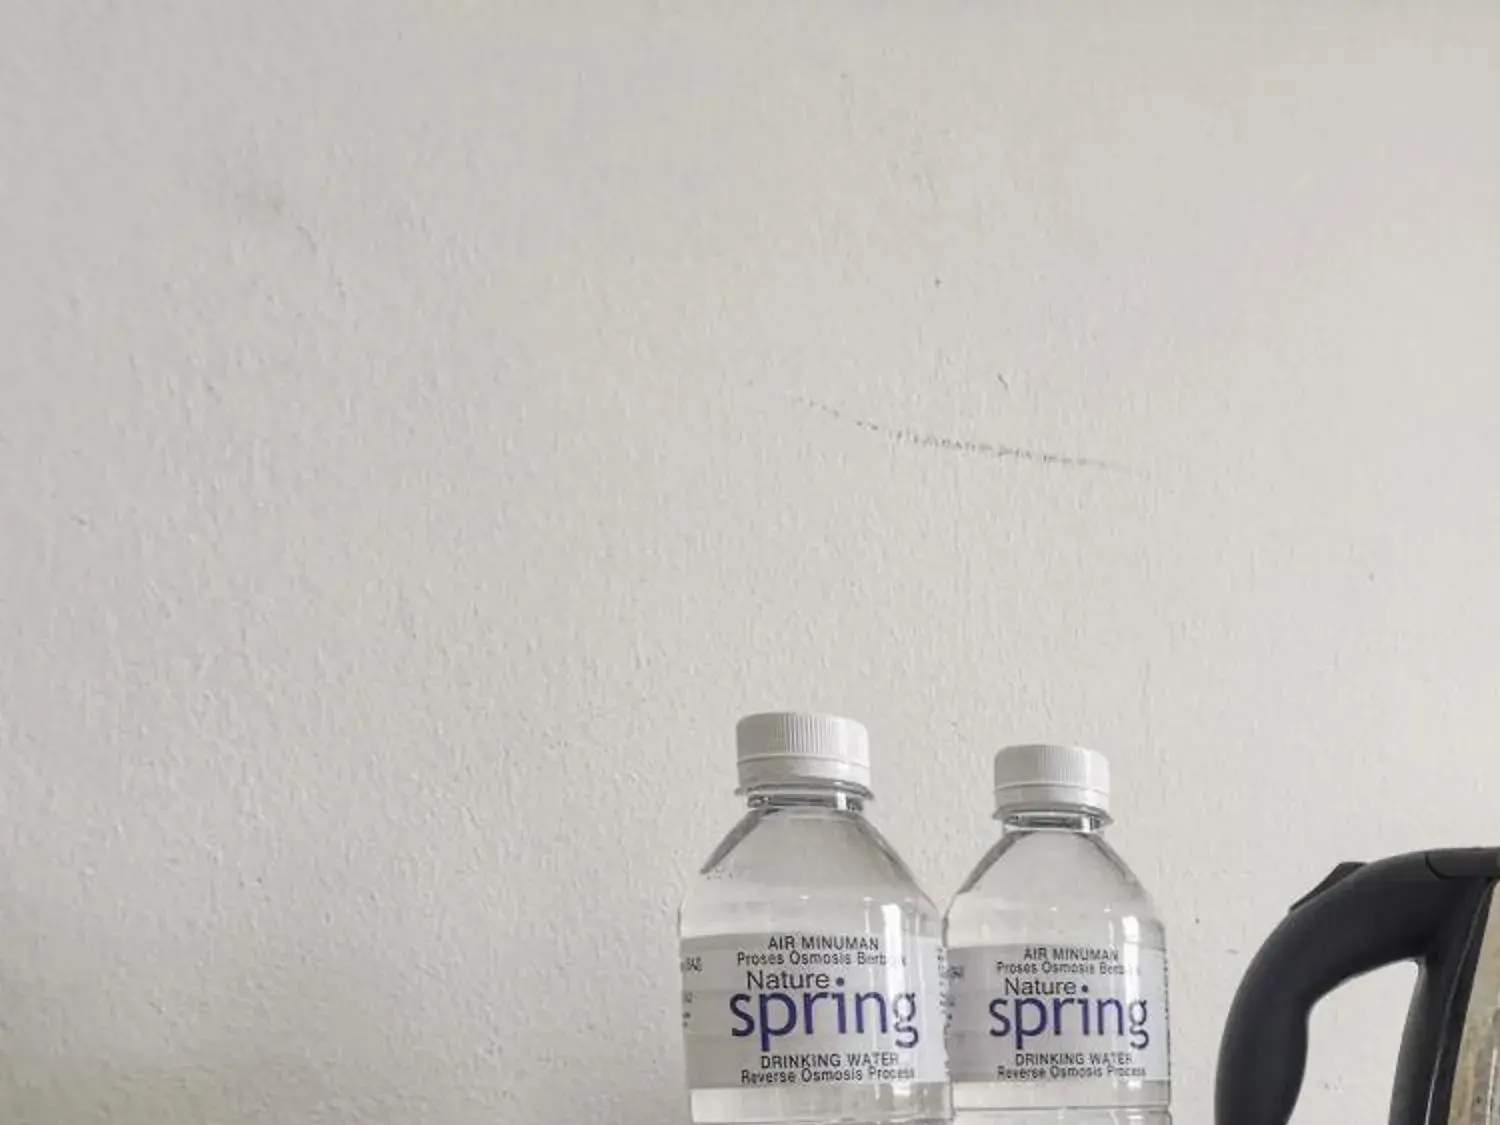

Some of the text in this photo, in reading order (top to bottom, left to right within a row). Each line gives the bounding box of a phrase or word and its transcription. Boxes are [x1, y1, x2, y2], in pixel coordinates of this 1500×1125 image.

[767, 936, 879, 950] AIR MINUMAN
[737, 952, 785, 966] Proses
[789, 951, 852, 966] Osmosis
[1023, 948, 1119, 961] AIR MINUMAN
[997, 962, 1038, 974] Proses
[746, 970, 830, 990] Nature
[1005, 978, 1077, 996] Nature
[729, 977, 920, 1052] spring
[989, 984, 1149, 1051] spring
[761, 1053, 899, 1069] DRINKING WATER
[1015, 1053, 1133, 1066] DRINKING WATER
[741, 1070, 796, 1084] Reverse
[801, 1069, 863, 1083] Osmosis
[997, 1066, 1046, 1079] Reverse
[1050, 1066, 1103, 1079] Osmosis
